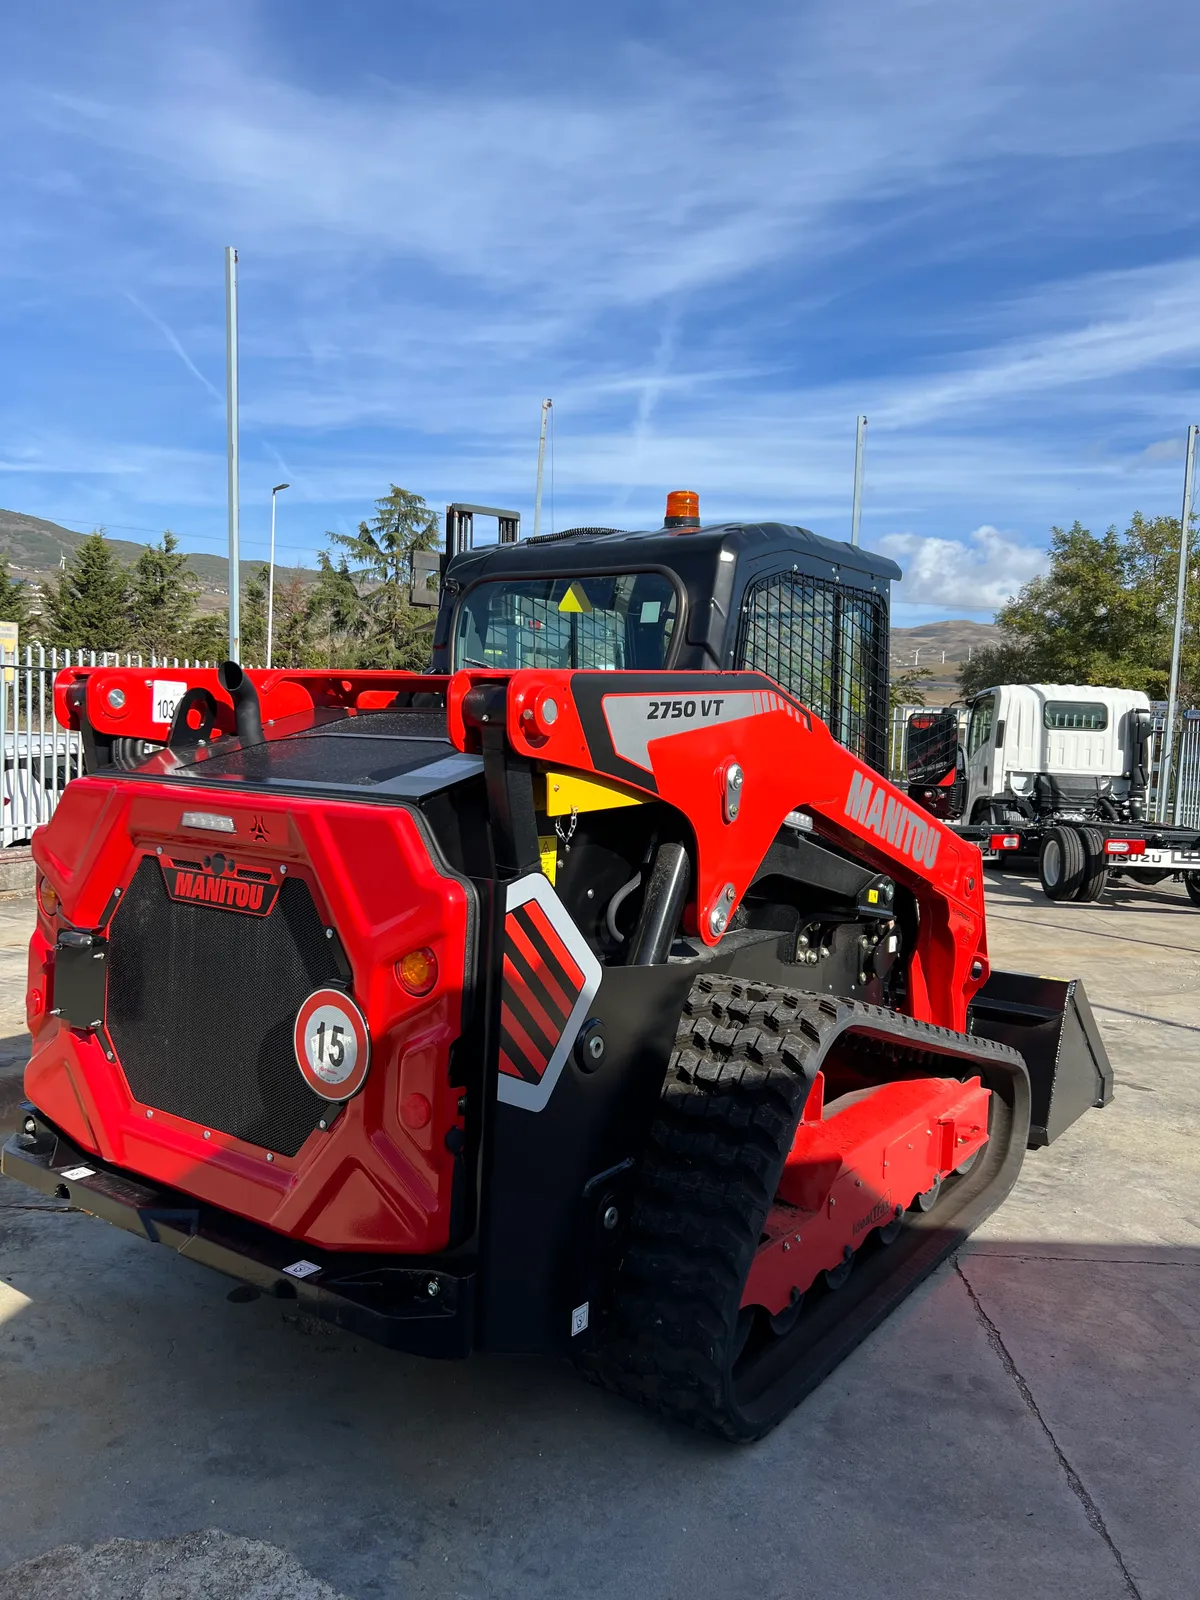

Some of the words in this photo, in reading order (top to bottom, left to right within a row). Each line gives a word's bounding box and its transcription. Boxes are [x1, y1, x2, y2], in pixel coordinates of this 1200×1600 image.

[647, 700, 697, 720] 2750
[701, 699, 724, 717] VT
[844, 769, 941, 870] MANITOU
[1112, 853, 1162, 863] ISUZU
[174, 871, 265, 910] MANITOU
[316, 1021, 346, 1068] 15
